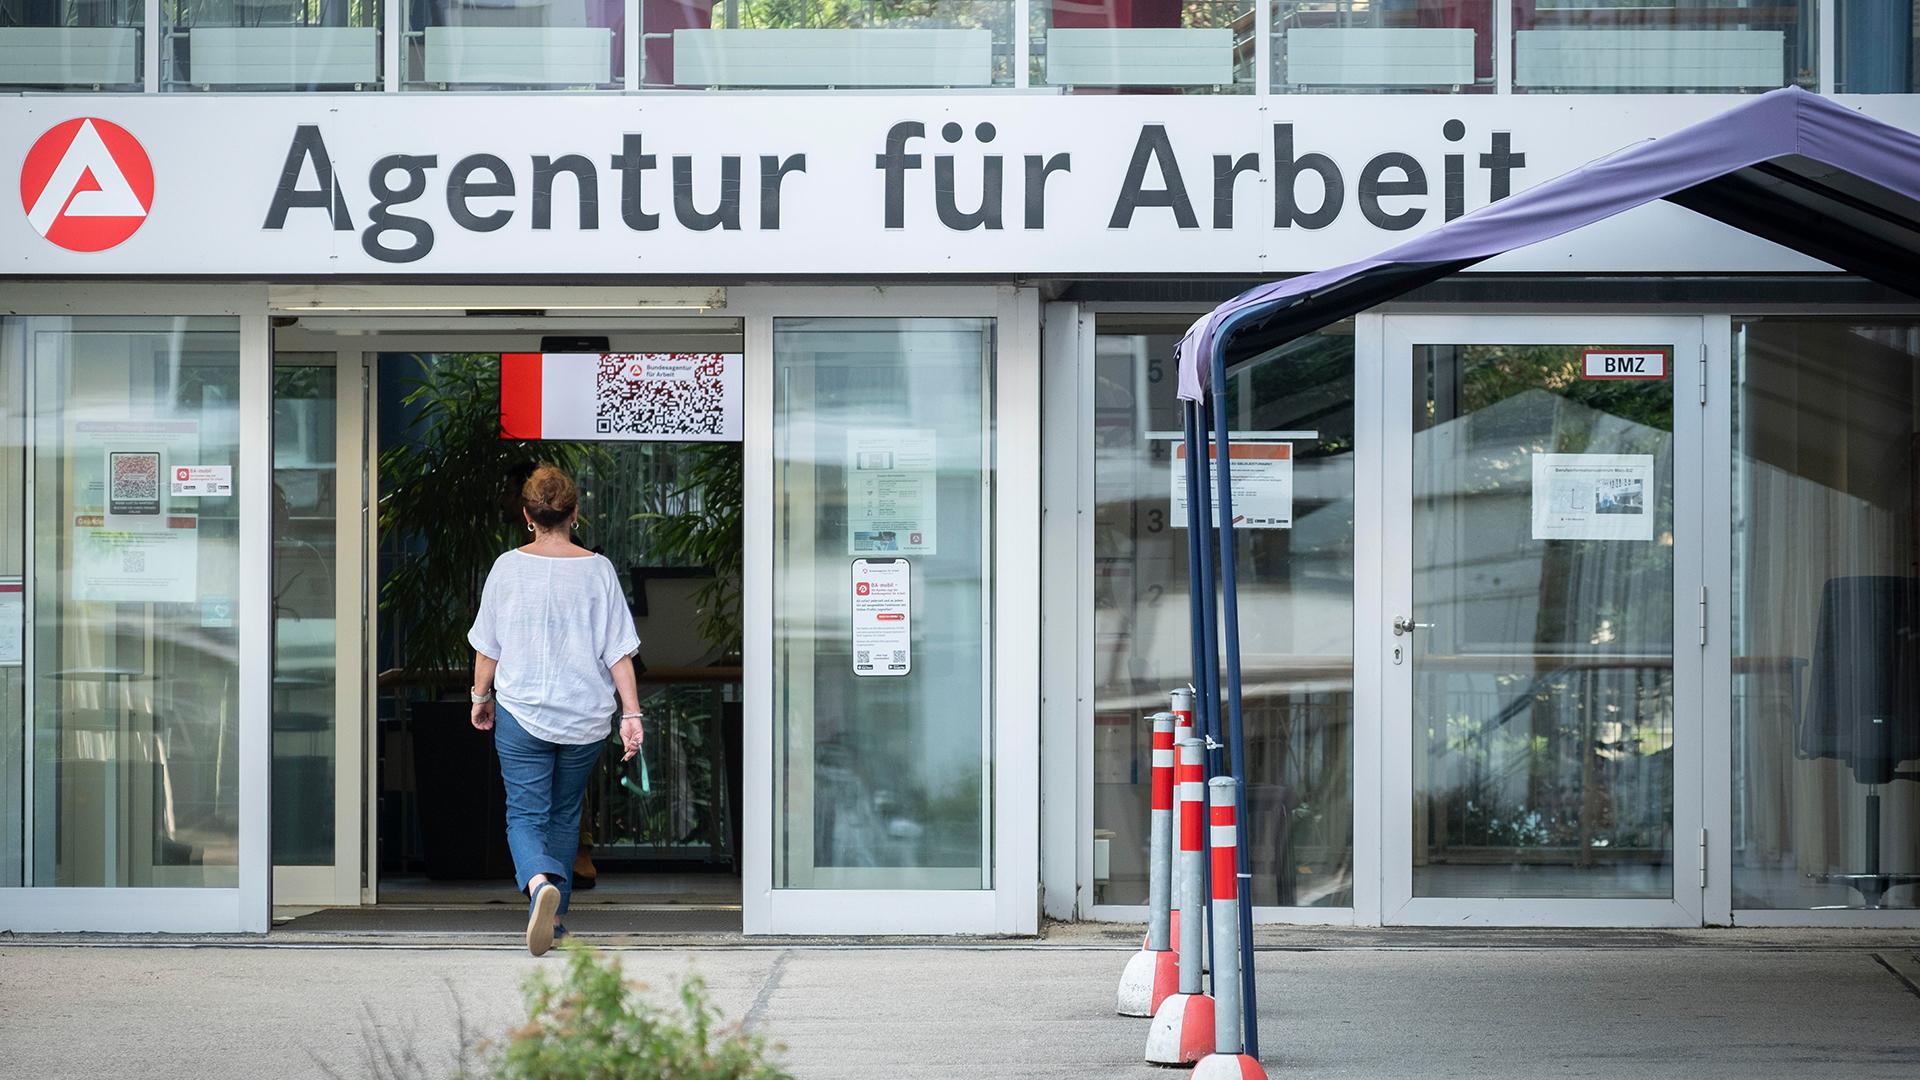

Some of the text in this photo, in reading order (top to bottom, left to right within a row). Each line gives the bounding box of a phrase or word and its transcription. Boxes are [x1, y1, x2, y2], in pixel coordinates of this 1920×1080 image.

[263, 119, 1526, 263] Agentur für Arbeit
[646, 364, 692, 372] Bundesagentur
[1148, 359, 1164, 384] 5
[1605, 357, 1645, 373] BMZ
[1146, 508, 1164, 534] 3
[1147, 583, 1164, 608] 2
